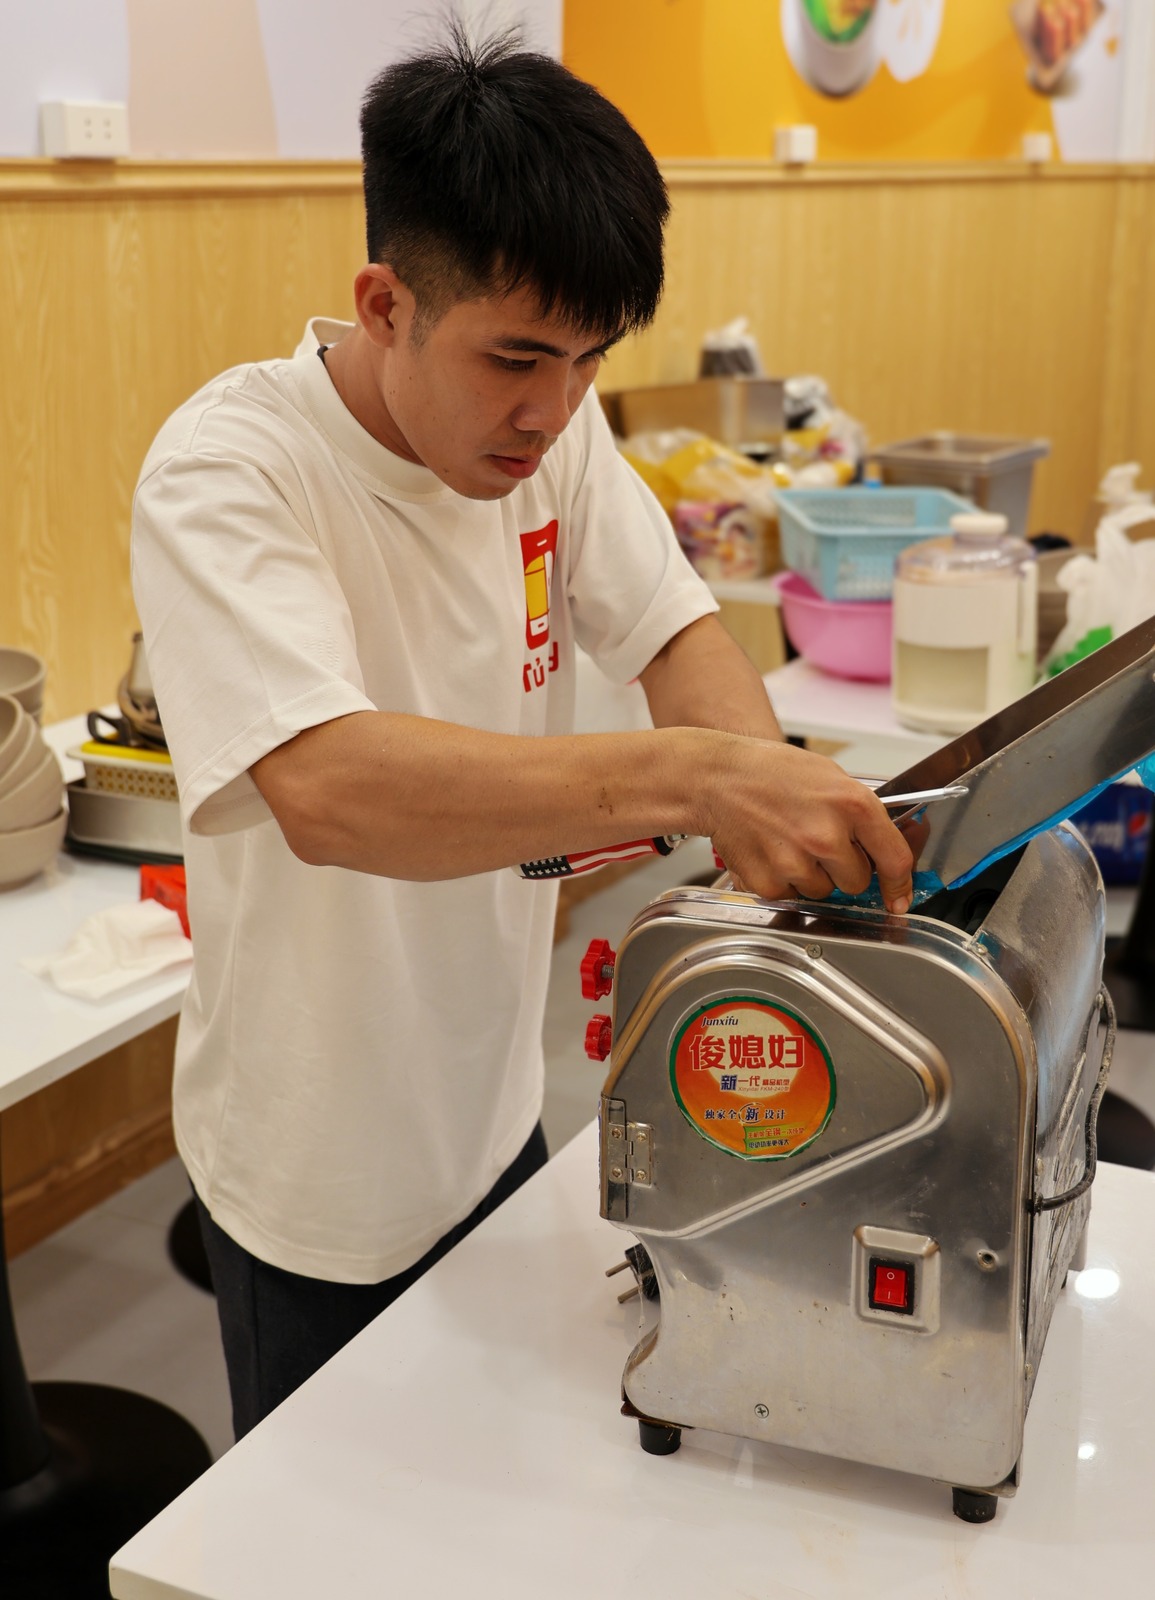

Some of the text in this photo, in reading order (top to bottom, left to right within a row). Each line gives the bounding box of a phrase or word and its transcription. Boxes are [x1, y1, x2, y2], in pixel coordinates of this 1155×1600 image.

[702, 1015, 739, 1027] Junxifu
[689, 1034, 805, 1071] 俊媳妇
[720, 1074, 761, 1091] 新一代
[704, 1106, 786, 1121] 独家全新设计
